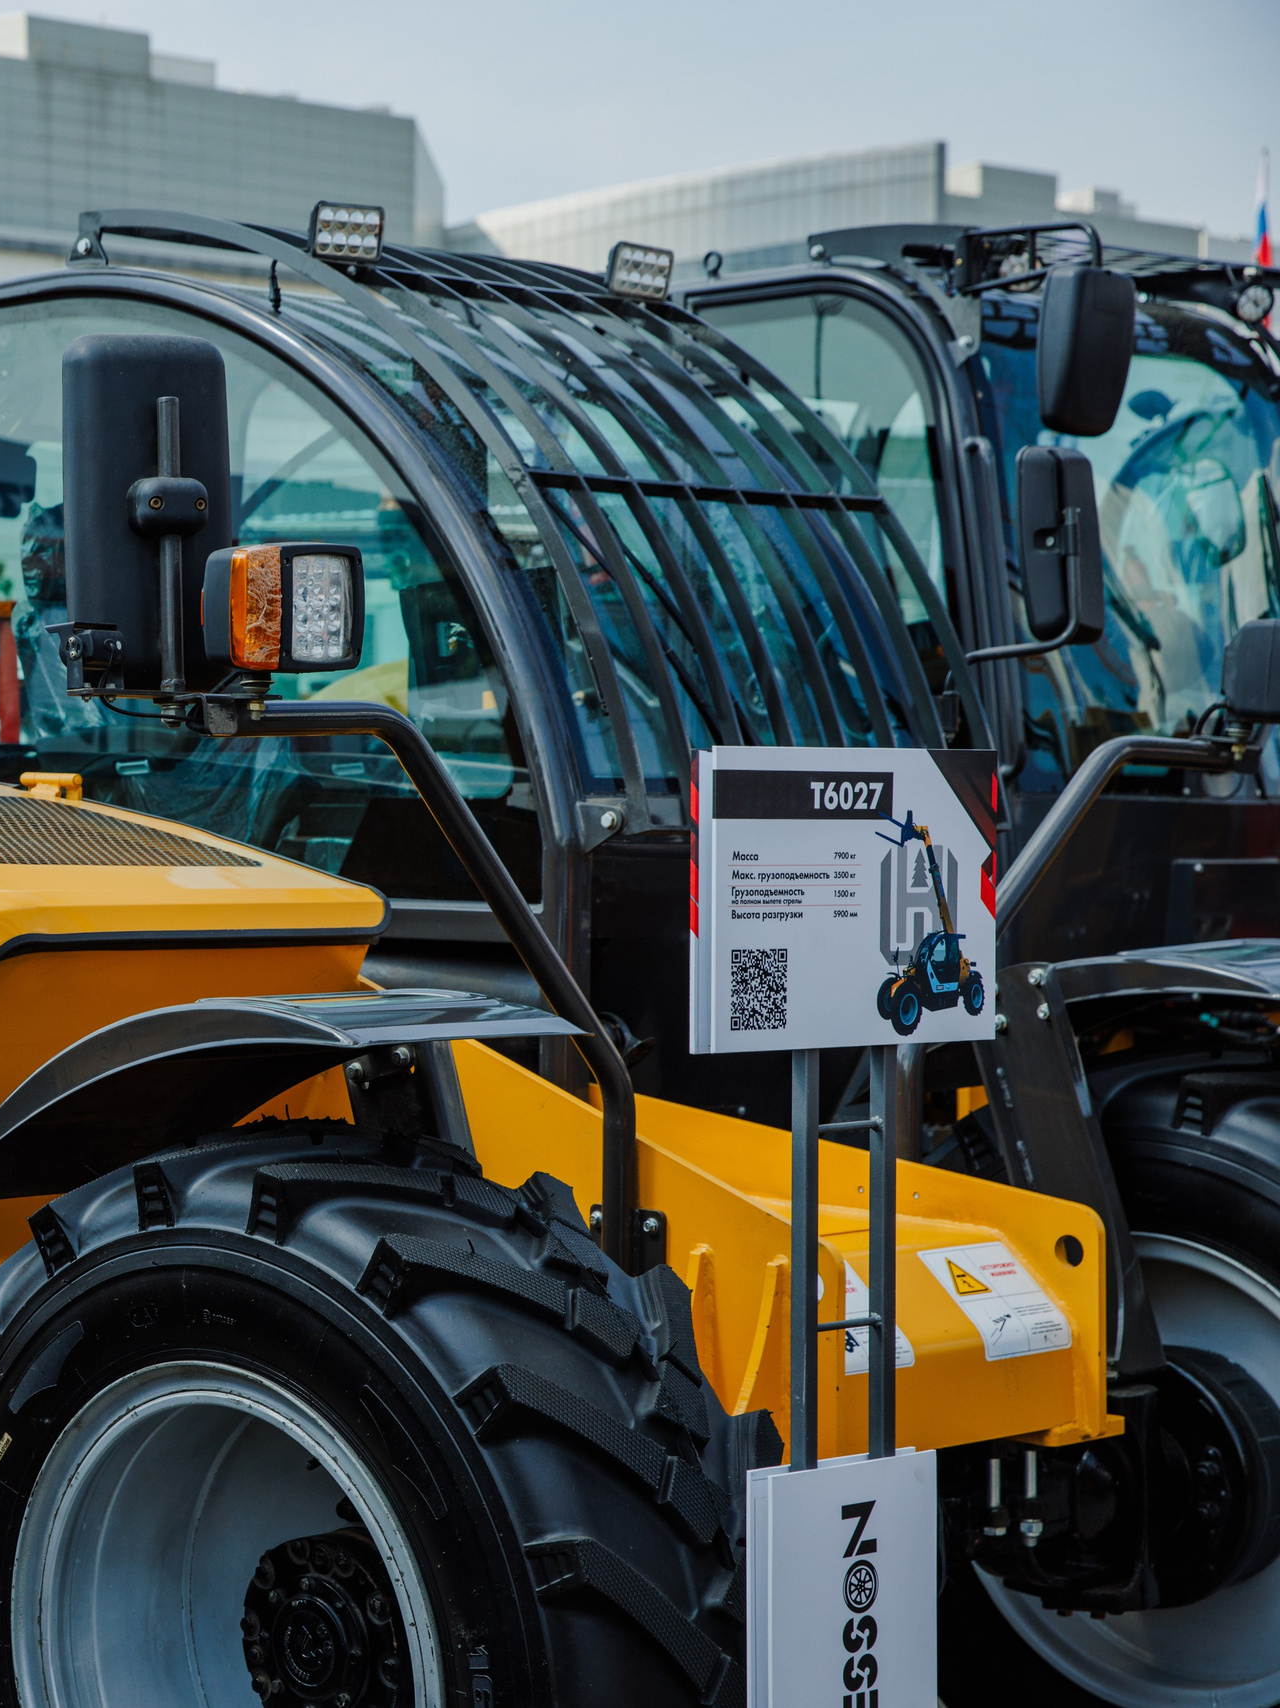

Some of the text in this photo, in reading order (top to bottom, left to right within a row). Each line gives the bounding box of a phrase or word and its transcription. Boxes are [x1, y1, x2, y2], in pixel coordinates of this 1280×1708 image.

[810, 781, 884, 810] T6027
[732, 850, 759, 861] Масса
[833, 851, 850, 860] 7900
[731, 869, 756, 880] Макс.
[757, 871, 831, 883] грузоподъемность
[833, 870, 850, 879] 3500
[731, 886, 805, 899] Грузоподъемность
[833, 890, 849, 898] 1500
[731, 909, 760, 919] Высота
[761, 910, 803, 922] разгрузки
[833, 910, 849, 918] 5900
